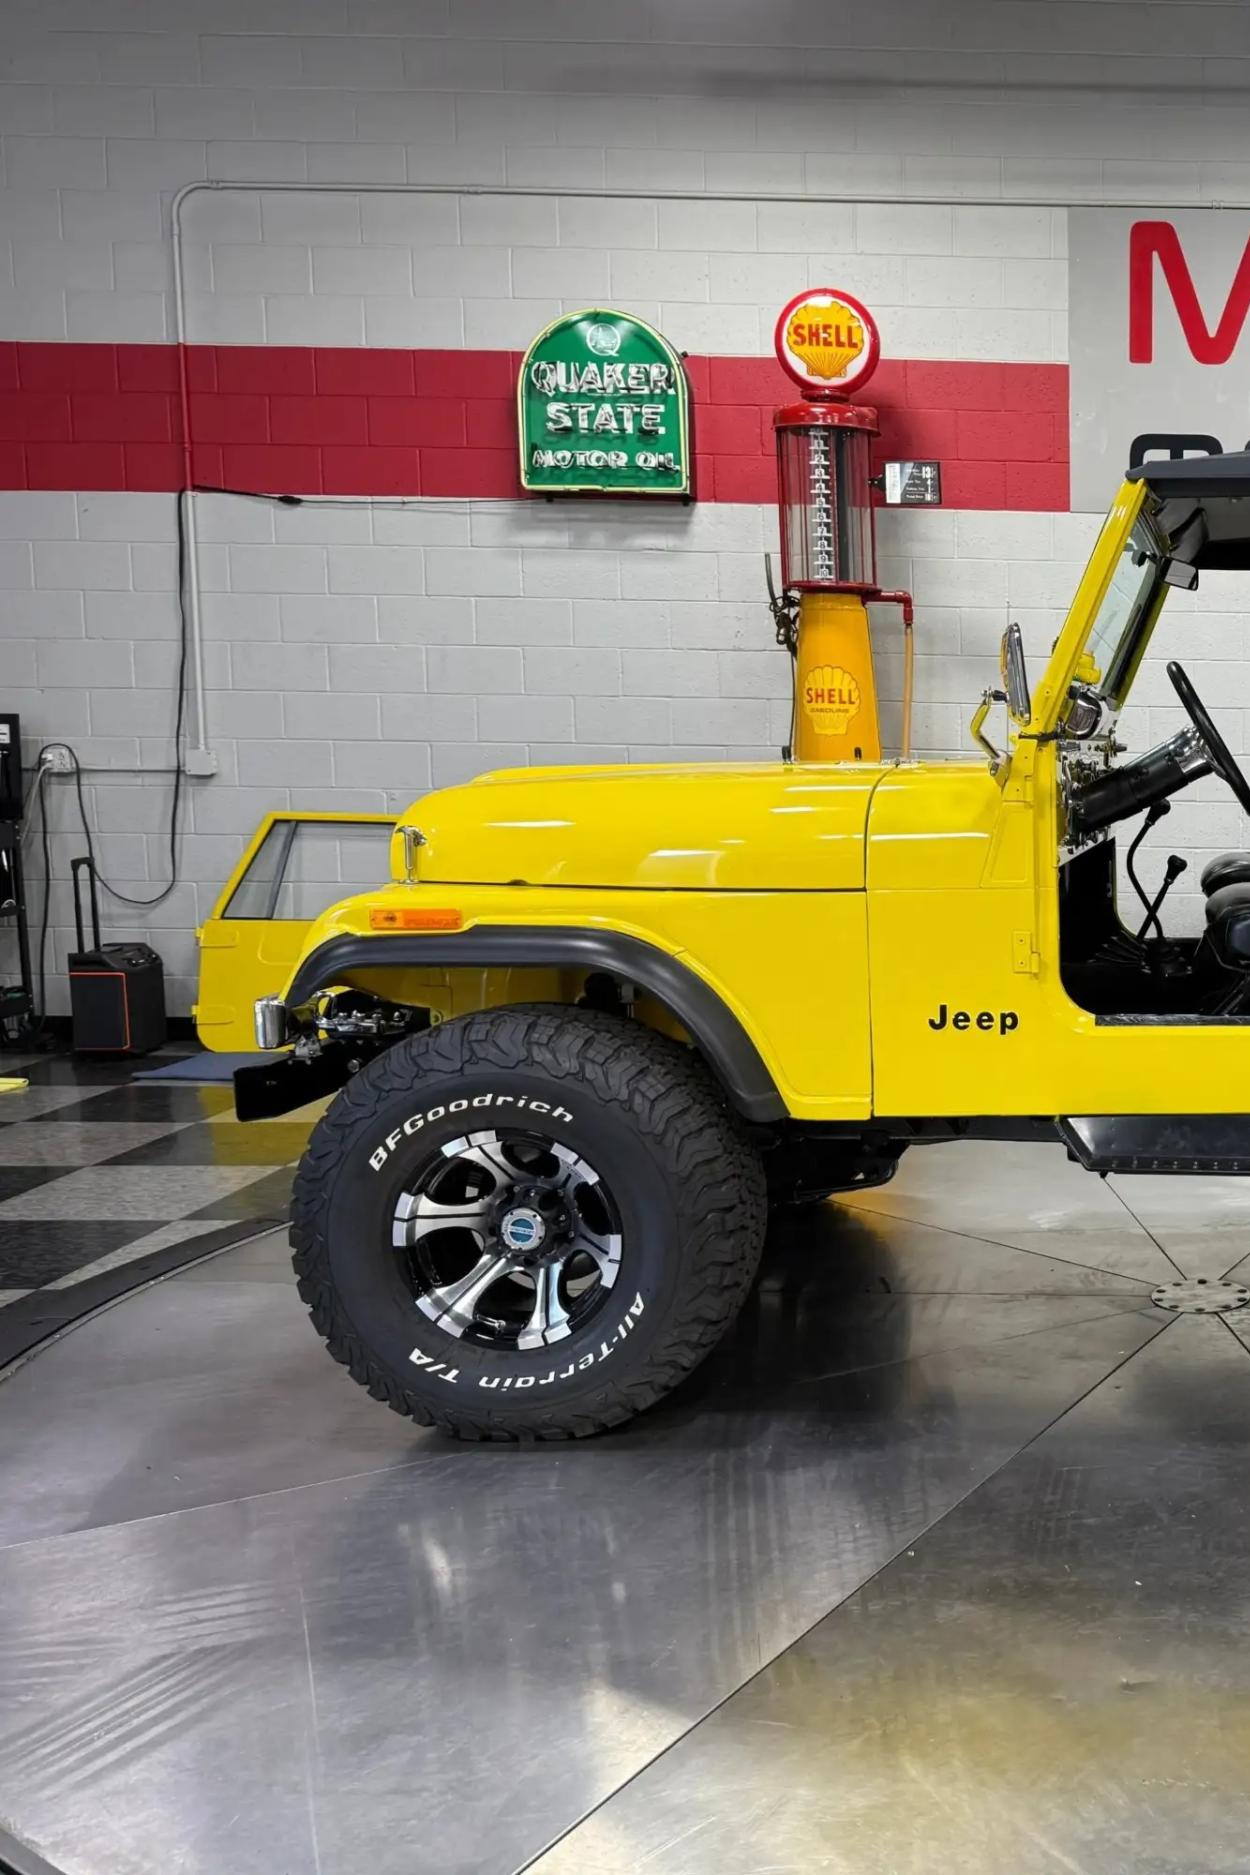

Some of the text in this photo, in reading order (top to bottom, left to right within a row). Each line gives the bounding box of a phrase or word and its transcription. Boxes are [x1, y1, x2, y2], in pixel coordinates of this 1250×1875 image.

[793, 323, 858, 349] SHELL
[531, 361, 676, 396] QUAKER
[546, 401, 666, 434] STATE
[532, 450, 681, 471] MOTOR OIL
[806, 687, 855, 705] SHELL
[928, 1004, 1018, 1035] Jeep
[369, 1093, 573, 1171] BFGoodrich
[408, 1292, 644, 1391] All-Terrain T/A
